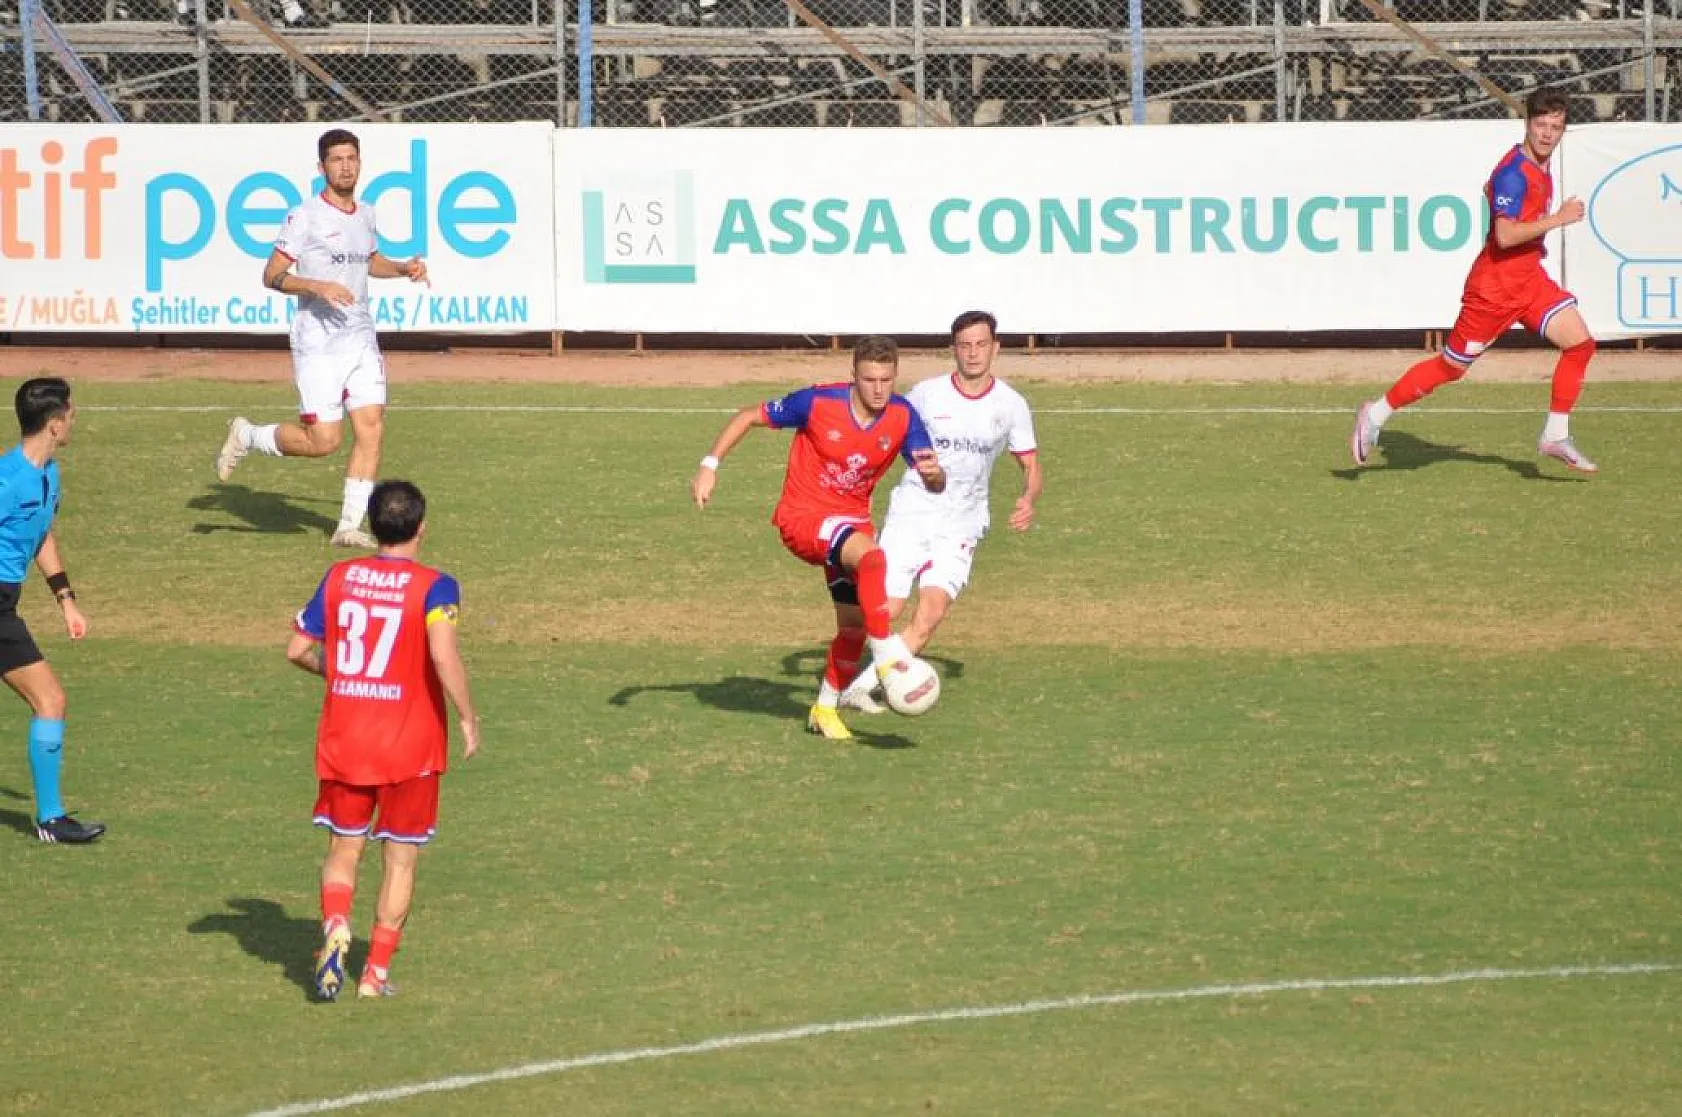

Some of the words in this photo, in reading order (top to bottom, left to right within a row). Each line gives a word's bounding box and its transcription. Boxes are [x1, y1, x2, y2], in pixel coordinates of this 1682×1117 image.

[145, 139, 516, 291] pede
[712, 198, 907, 255] ASSA
[929, 196, 1490, 255] CONSTRUCTIO
[31, 287, 120, 325] MUĞLA
[131, 295, 220, 332] Şehitler
[226, 295, 279, 325] Cad.
[368, 295, 407, 331] AŞ
[429, 295, 528, 325] KALKAN
[345, 564, 412, 589] ESNAF
[336, 600, 403, 677] 37
